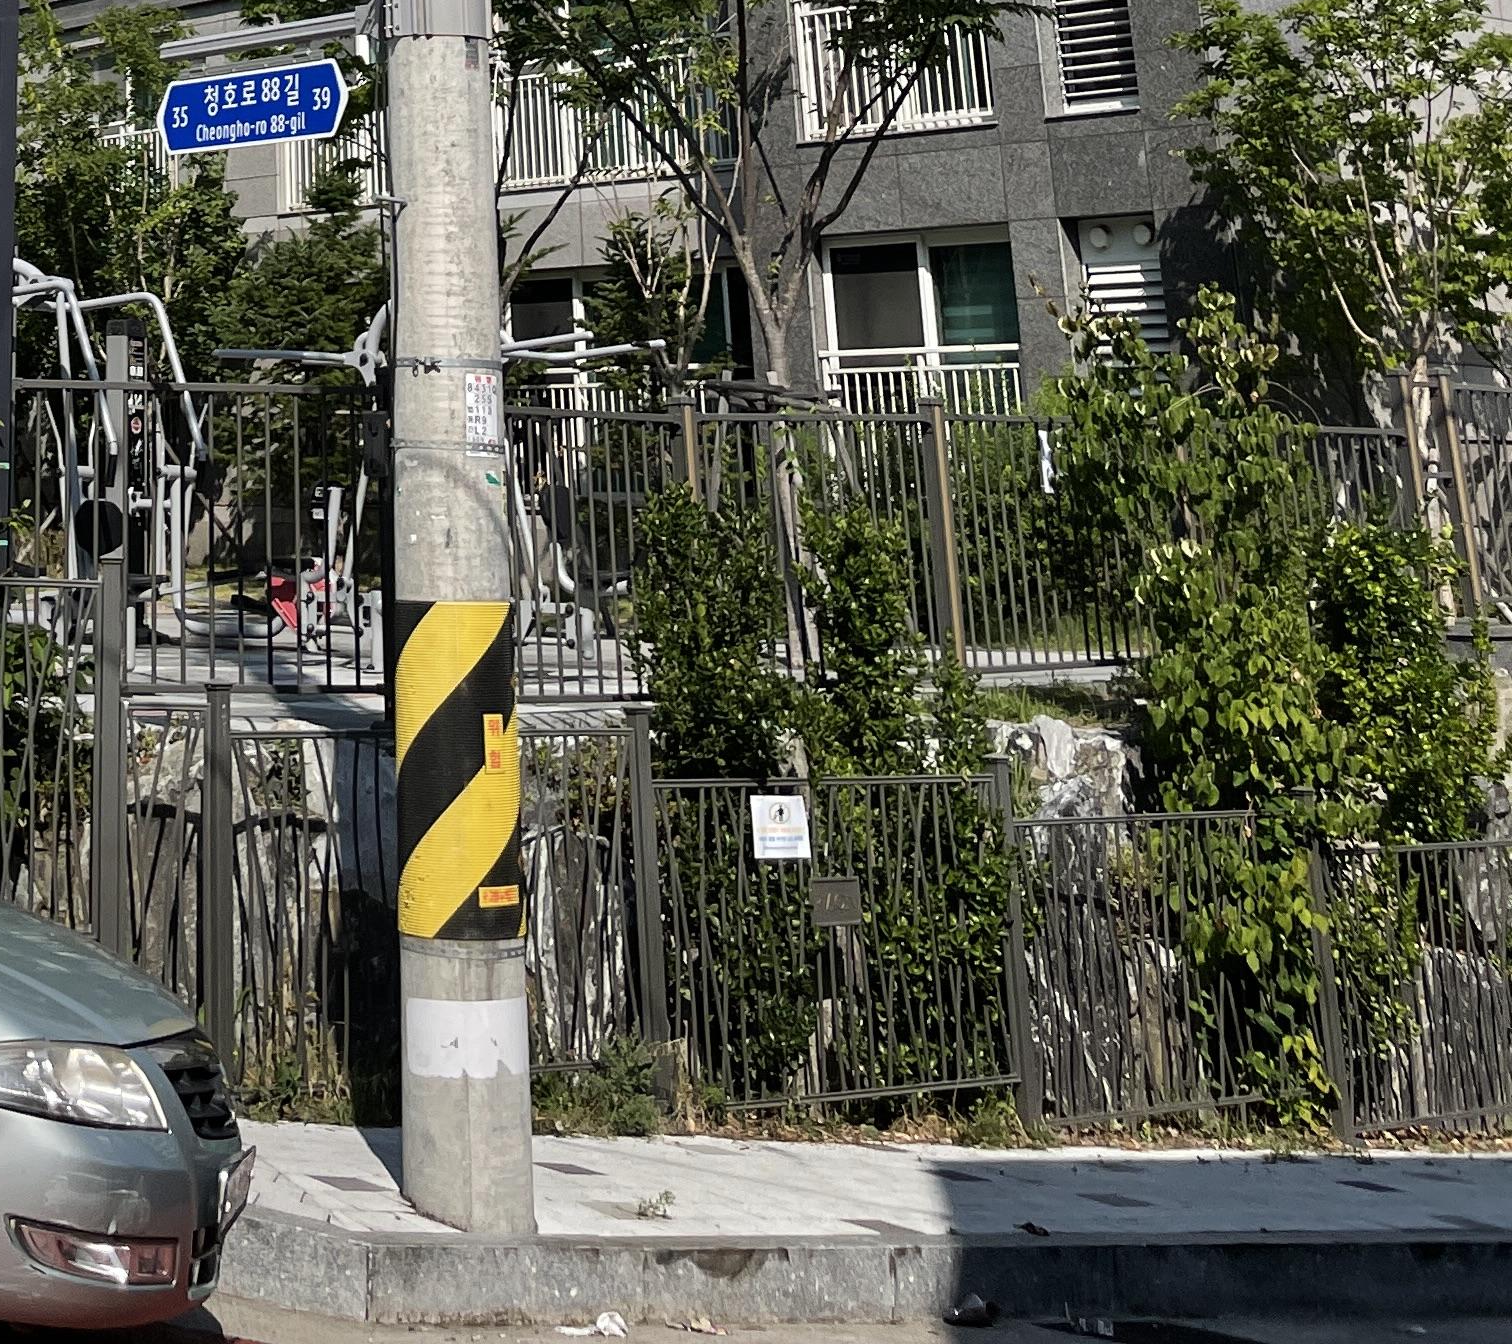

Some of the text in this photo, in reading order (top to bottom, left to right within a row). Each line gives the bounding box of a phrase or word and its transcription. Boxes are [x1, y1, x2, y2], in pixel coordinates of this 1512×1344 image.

[313, 87, 331, 111] 39
[172, 106, 189, 128] 35
[196, 112, 306, 142] Cheongho-ro 88-gil
